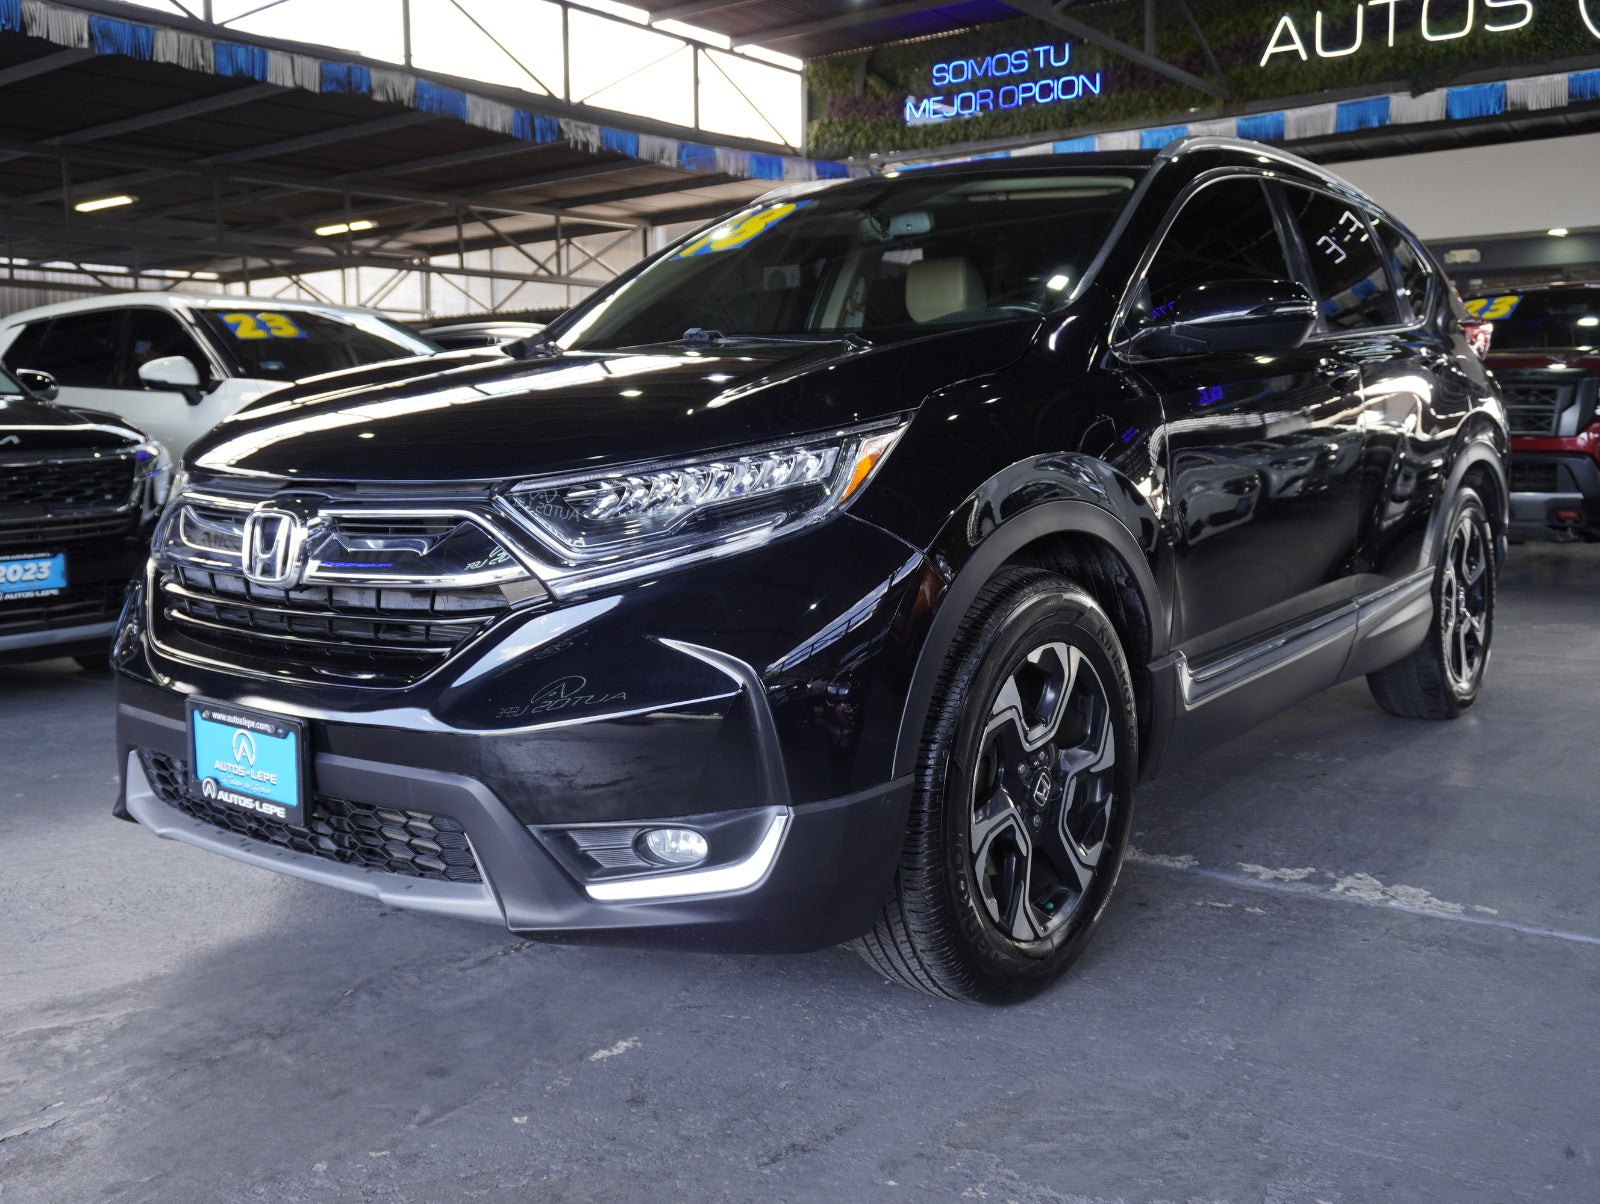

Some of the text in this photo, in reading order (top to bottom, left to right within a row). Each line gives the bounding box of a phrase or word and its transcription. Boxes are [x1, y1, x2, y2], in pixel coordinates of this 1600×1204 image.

[1259, 0, 1534, 67] AUTOS
[932, 42, 1070, 87] SOMOS TU
[905, 72, 1101, 126] MEJOR OPCION
[223, 312, 300, 339] 23
[1464, 295, 1520, 320] 23
[211, 711, 271, 731] www.autoslepe.com
